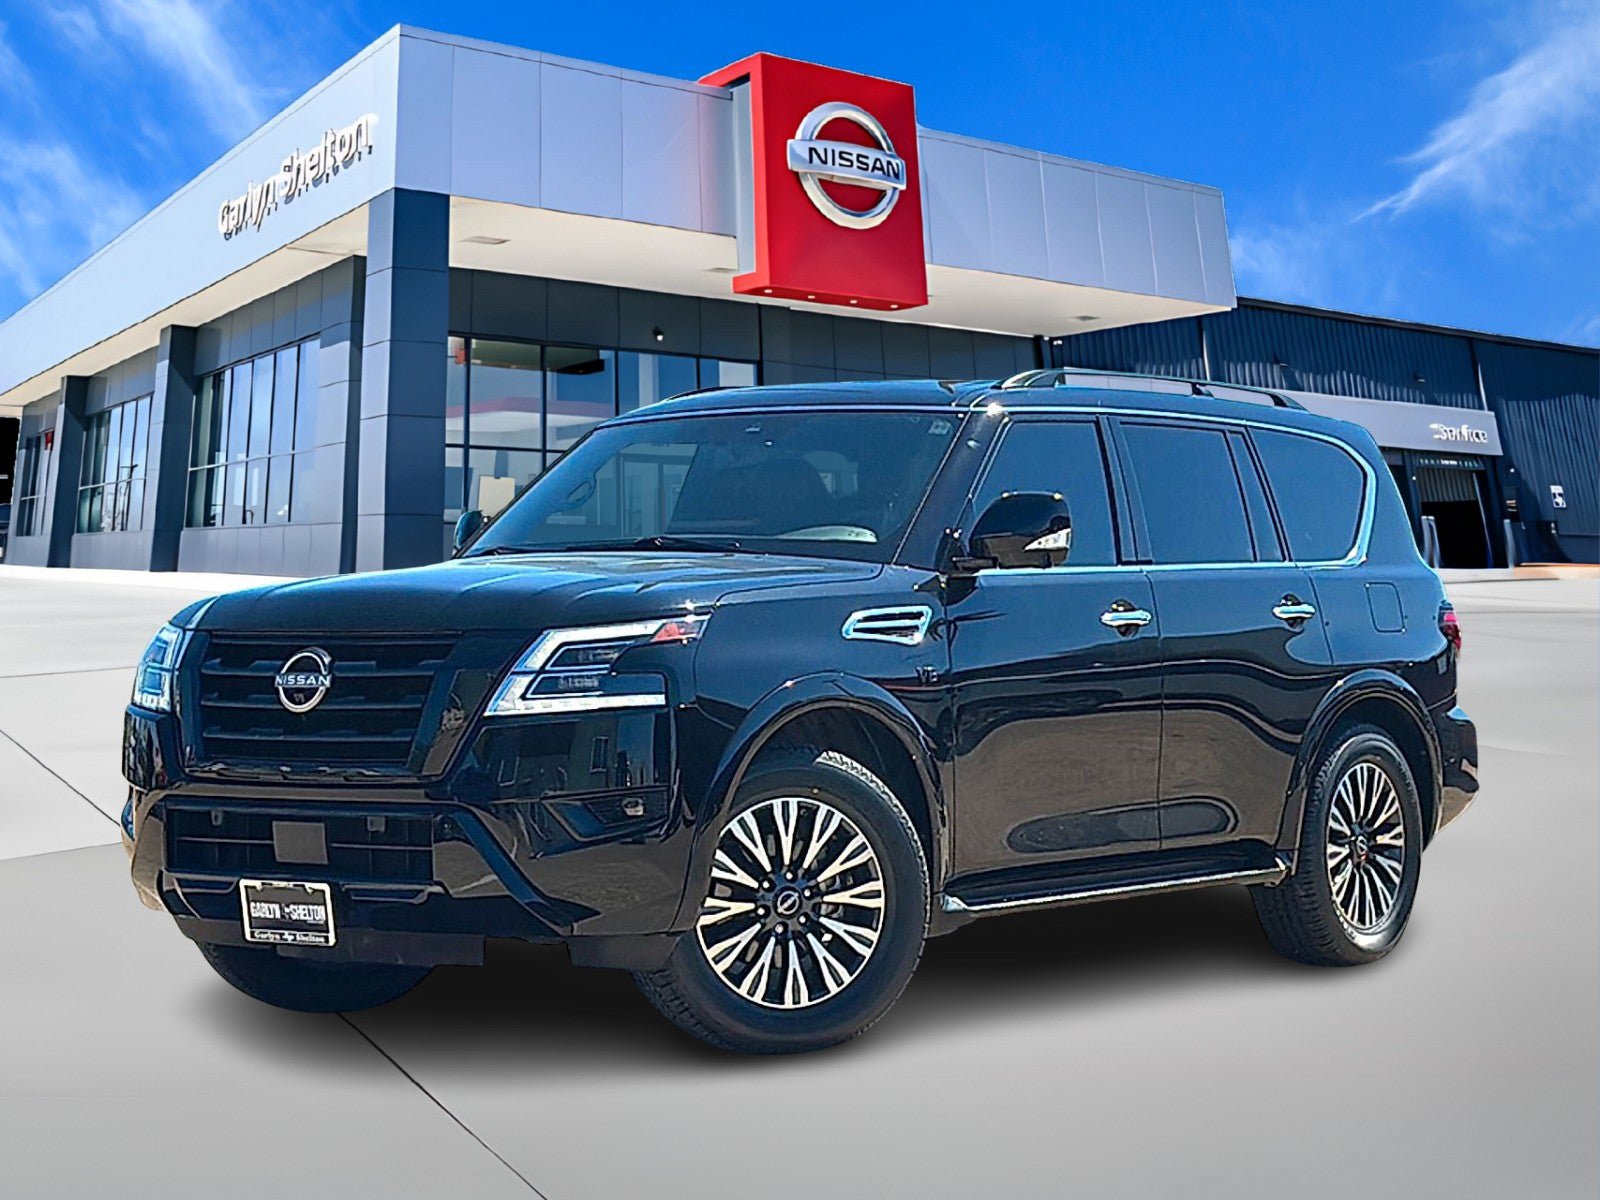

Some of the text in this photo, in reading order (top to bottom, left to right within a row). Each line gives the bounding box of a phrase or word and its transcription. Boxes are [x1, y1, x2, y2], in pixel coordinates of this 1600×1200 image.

[808, 146, 900, 180] NISSAN
[218, 114, 376, 238] Garlyn Shelton
[276, 675, 331, 686] NISSAN
[289, 904, 326, 921] SHELTON
